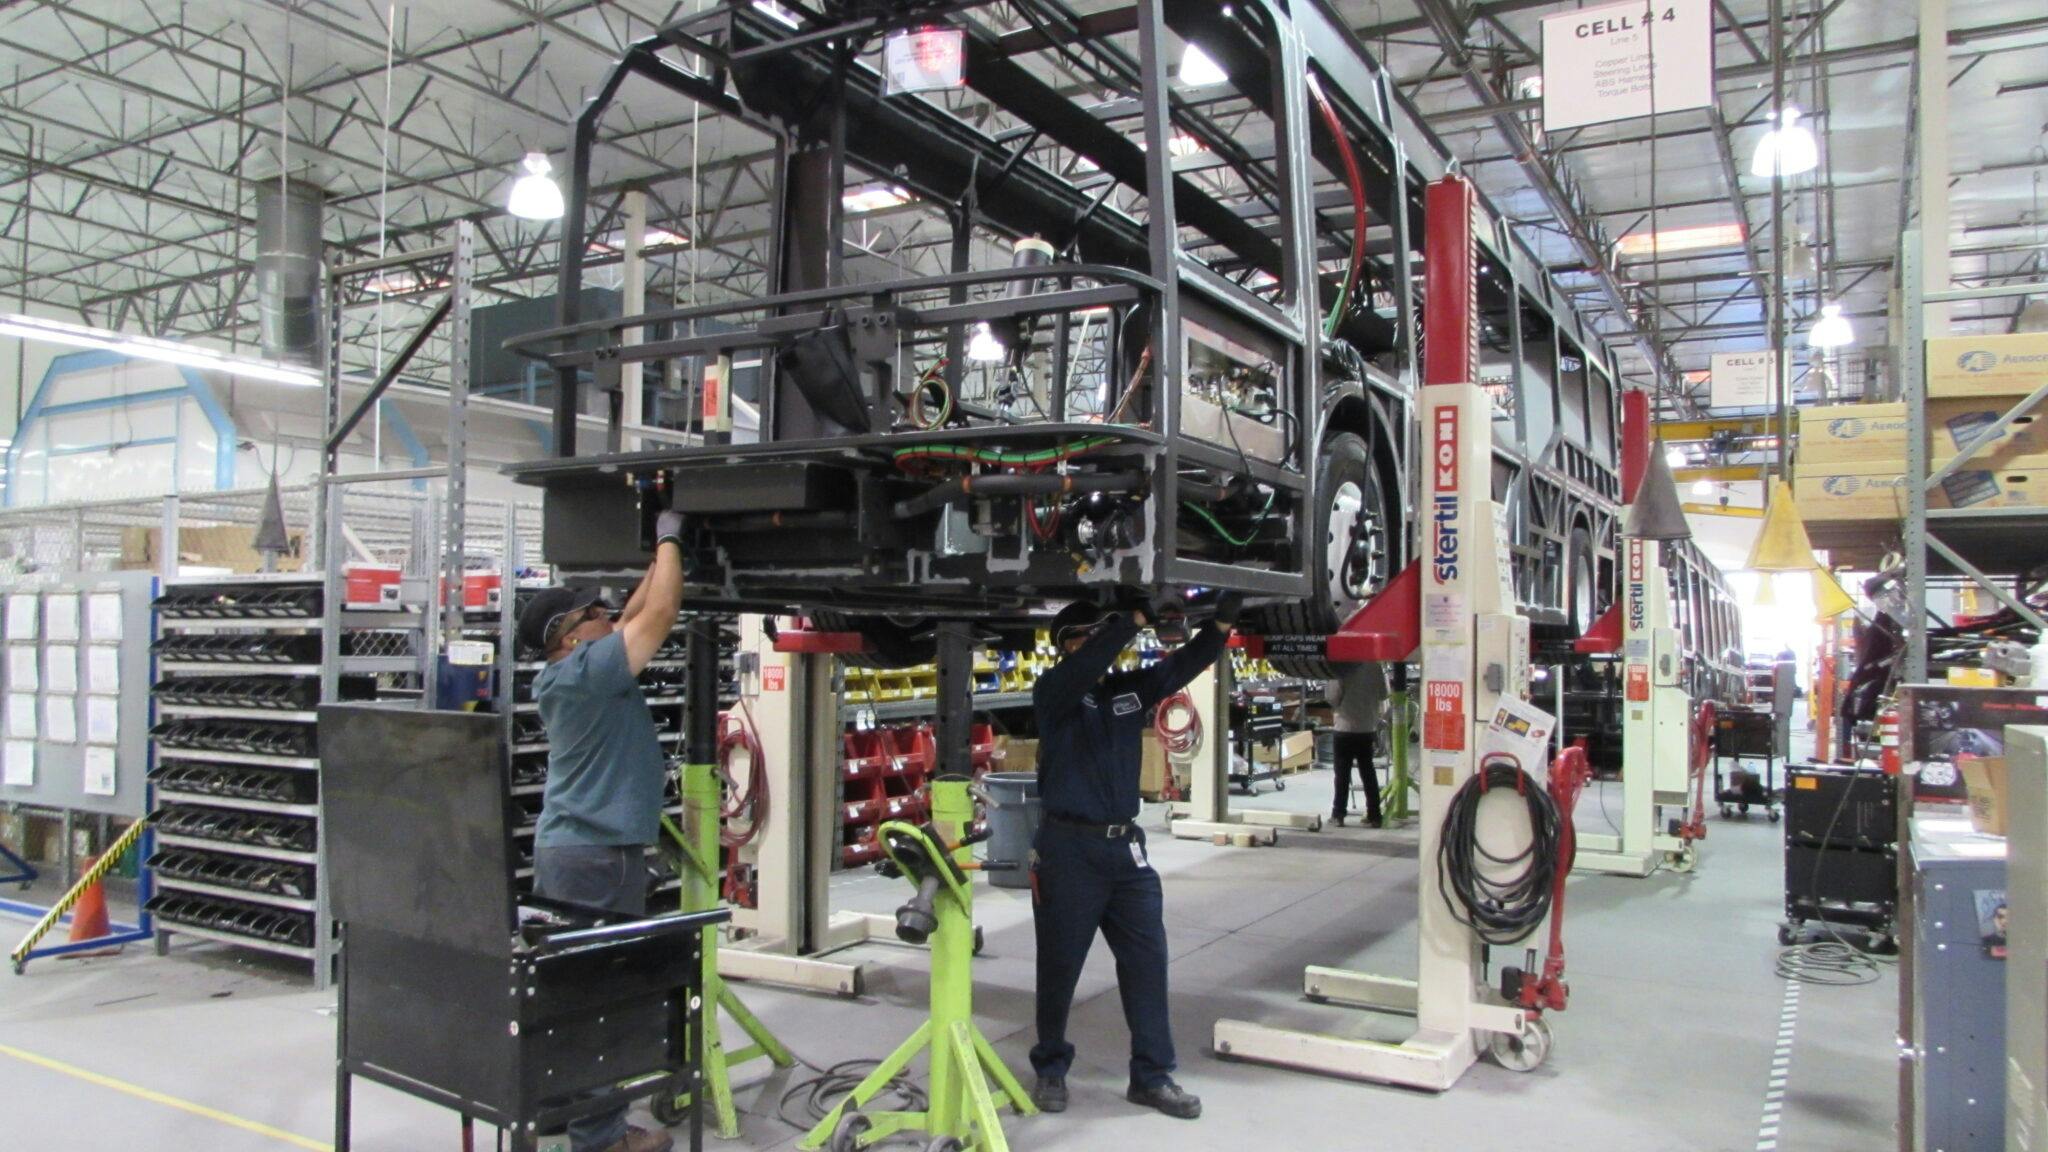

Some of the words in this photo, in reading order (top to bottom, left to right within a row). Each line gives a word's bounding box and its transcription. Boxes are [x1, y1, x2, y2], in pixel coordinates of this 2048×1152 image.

[1575, 16, 1633, 38] CELL
[1641, 11, 1654, 27] #
[1662, 7, 1675, 21] 4
[1726, 357, 1755, 367] CELL
[1439, 410, 1454, 488] KONI
[1433, 496, 1458, 585] stertil
[1630, 584, 1644, 632] stertil
[1429, 683, 1460, 698] 18000
[1435, 698, 1452, 712] lbs
